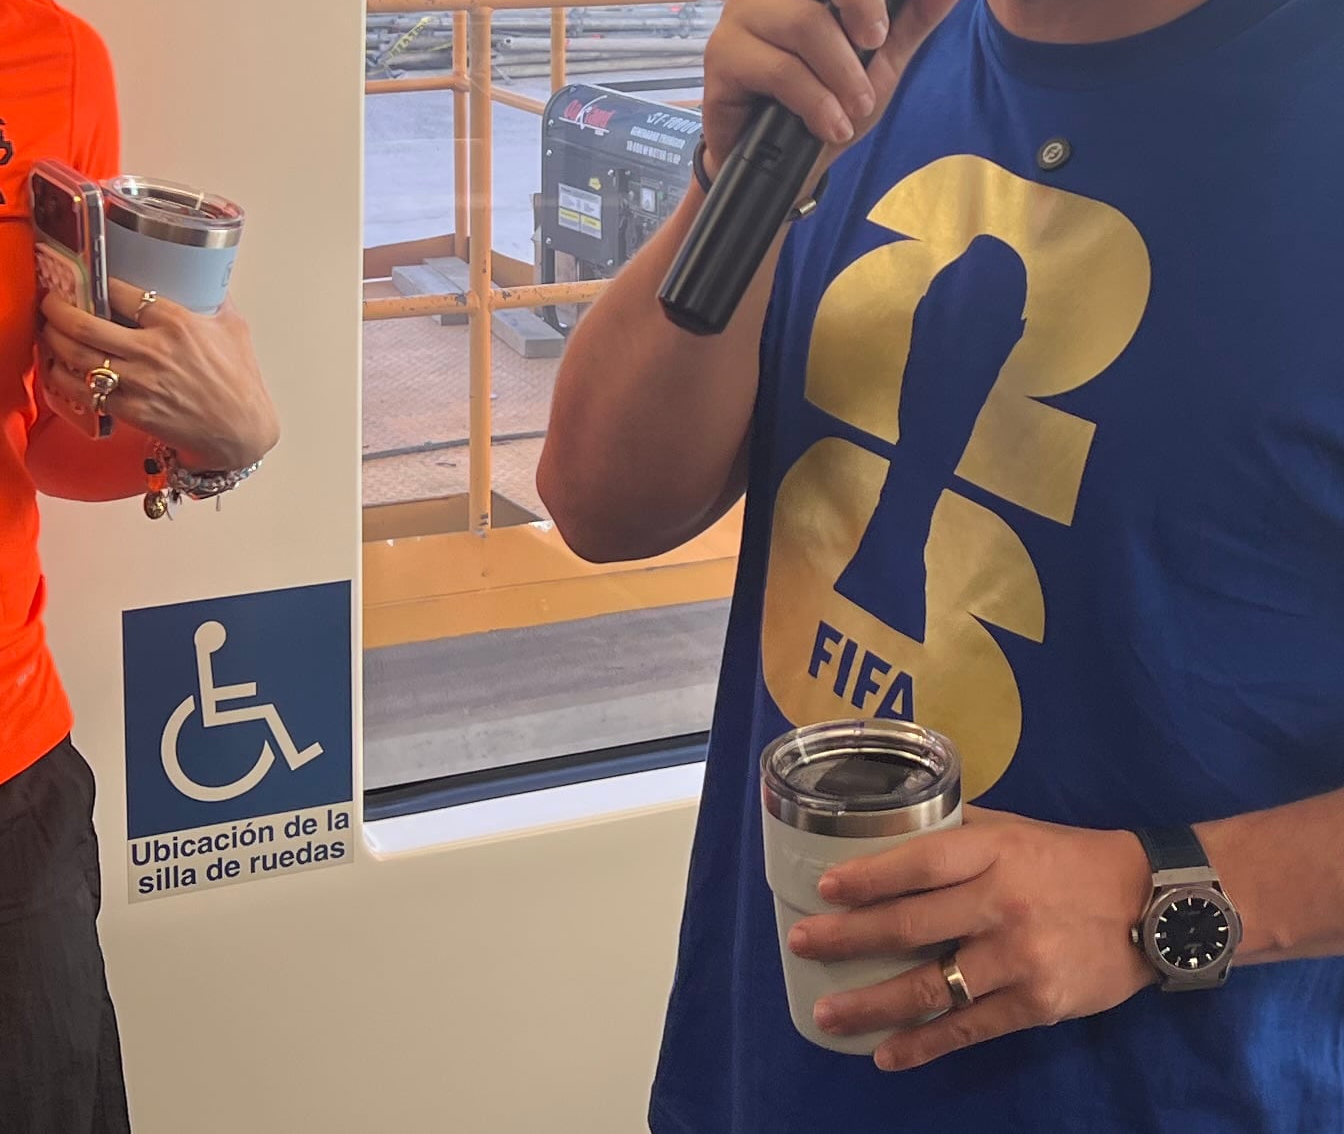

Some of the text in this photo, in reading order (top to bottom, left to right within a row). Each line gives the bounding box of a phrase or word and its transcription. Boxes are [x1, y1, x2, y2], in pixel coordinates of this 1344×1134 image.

[808, 620, 914, 723] FIFA
[131, 809, 350, 867] Ubicación de la
[137, 839, 346, 895] silla de ruedas
